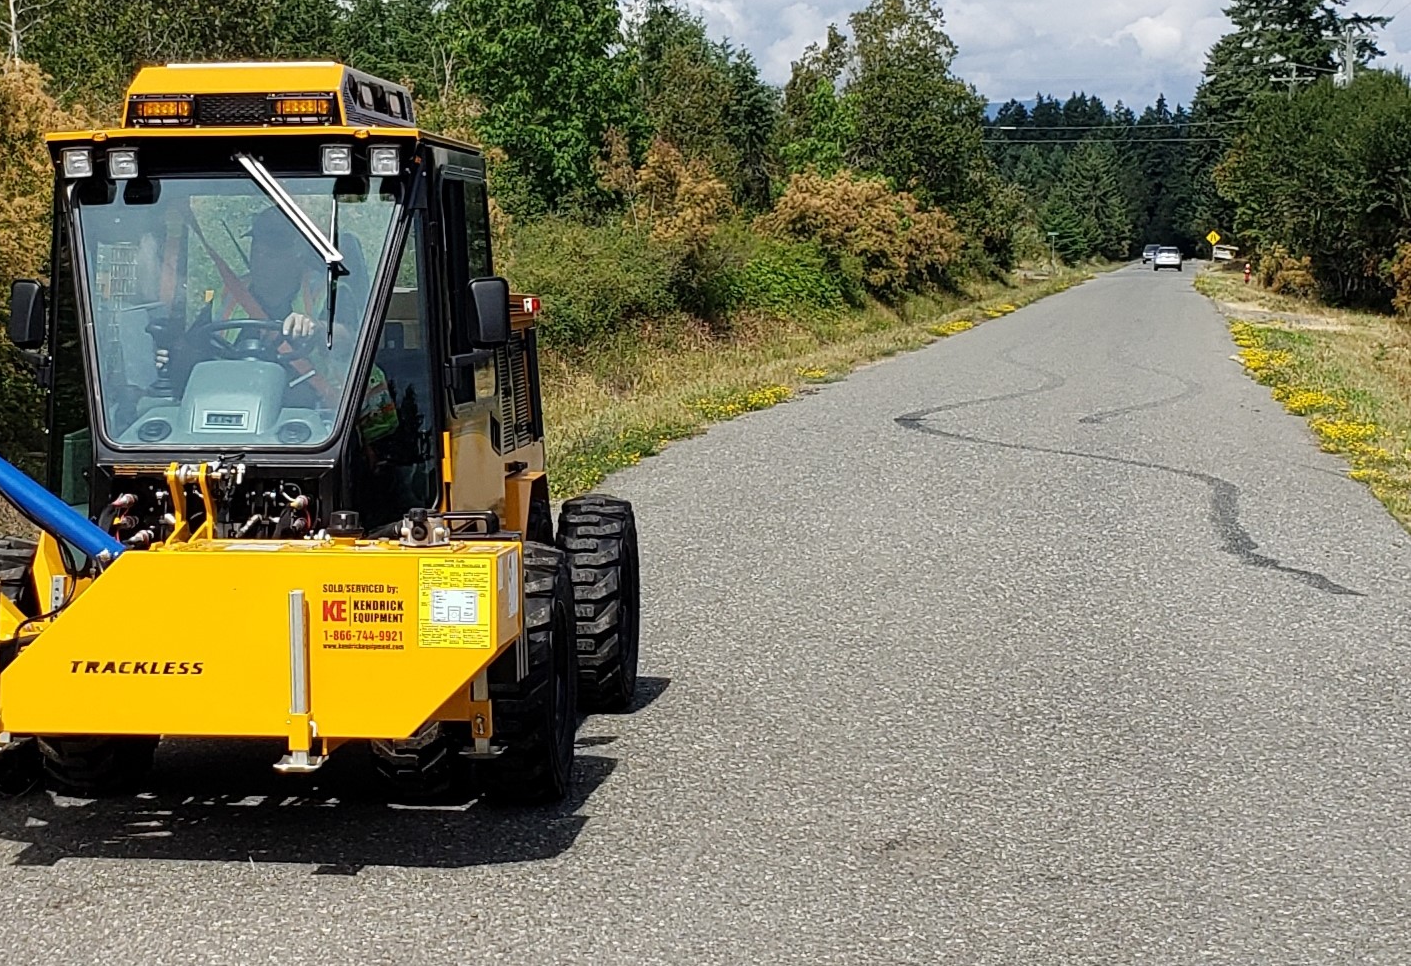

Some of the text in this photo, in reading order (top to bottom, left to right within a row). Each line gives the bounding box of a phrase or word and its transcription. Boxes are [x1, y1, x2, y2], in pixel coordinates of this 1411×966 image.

[386, 584, 399, 594] by:
[322, 600, 347, 622] KE
[353, 600, 404, 611] KENDRICK
[353, 613, 404, 624] EQUIPMENT
[323, 630, 403, 641] 1-866-744-9921
[70, 660, 204, 675] TRACKLESS
